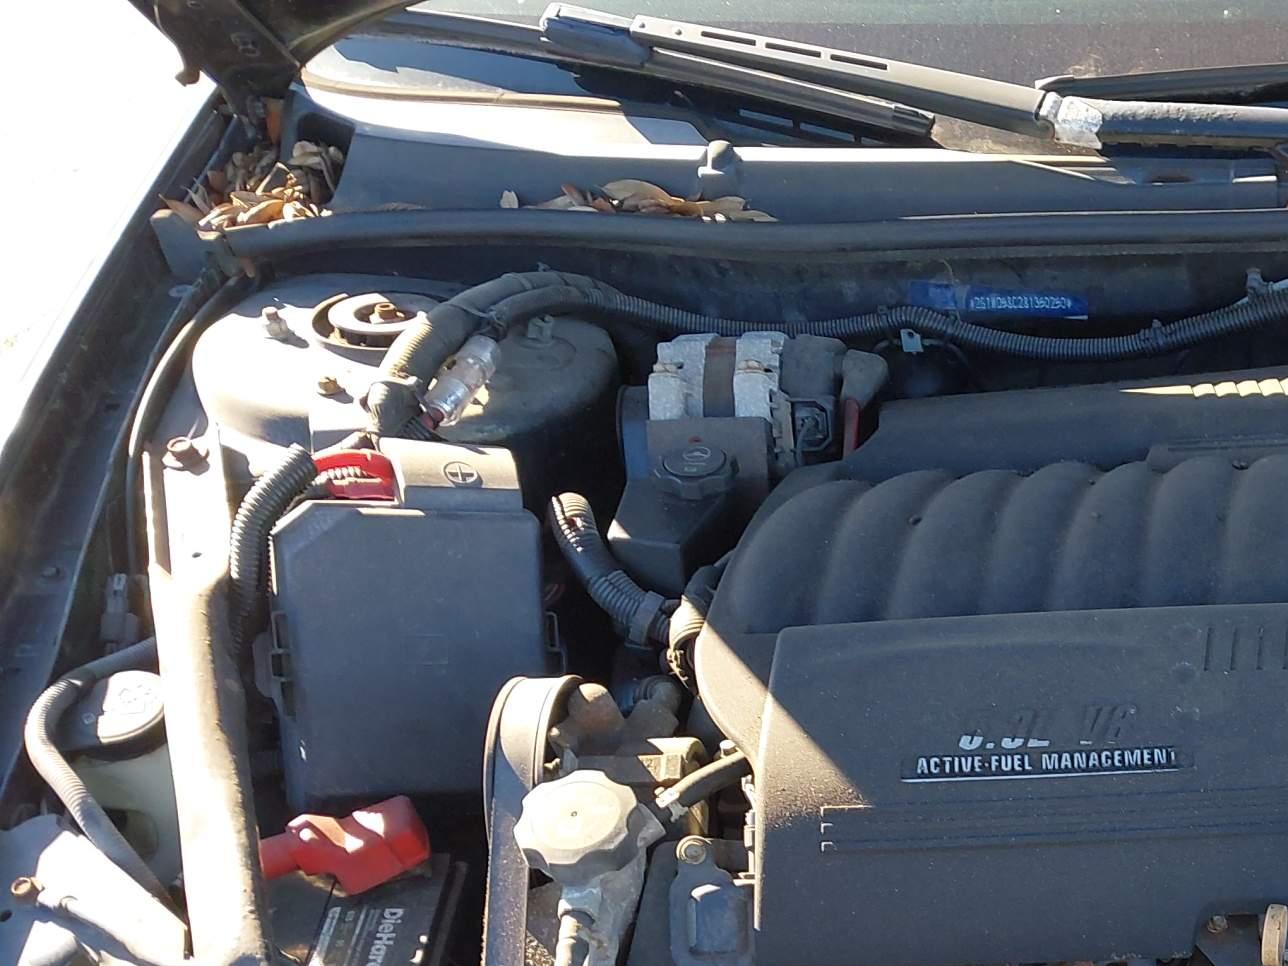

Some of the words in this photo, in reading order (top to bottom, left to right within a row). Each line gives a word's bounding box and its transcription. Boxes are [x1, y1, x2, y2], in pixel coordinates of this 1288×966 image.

[917, 756, 983, 774] ACTIVE
[991, 754, 1032, 772] FUEL
[1042, 748, 1176, 770] MANAGEMENT
